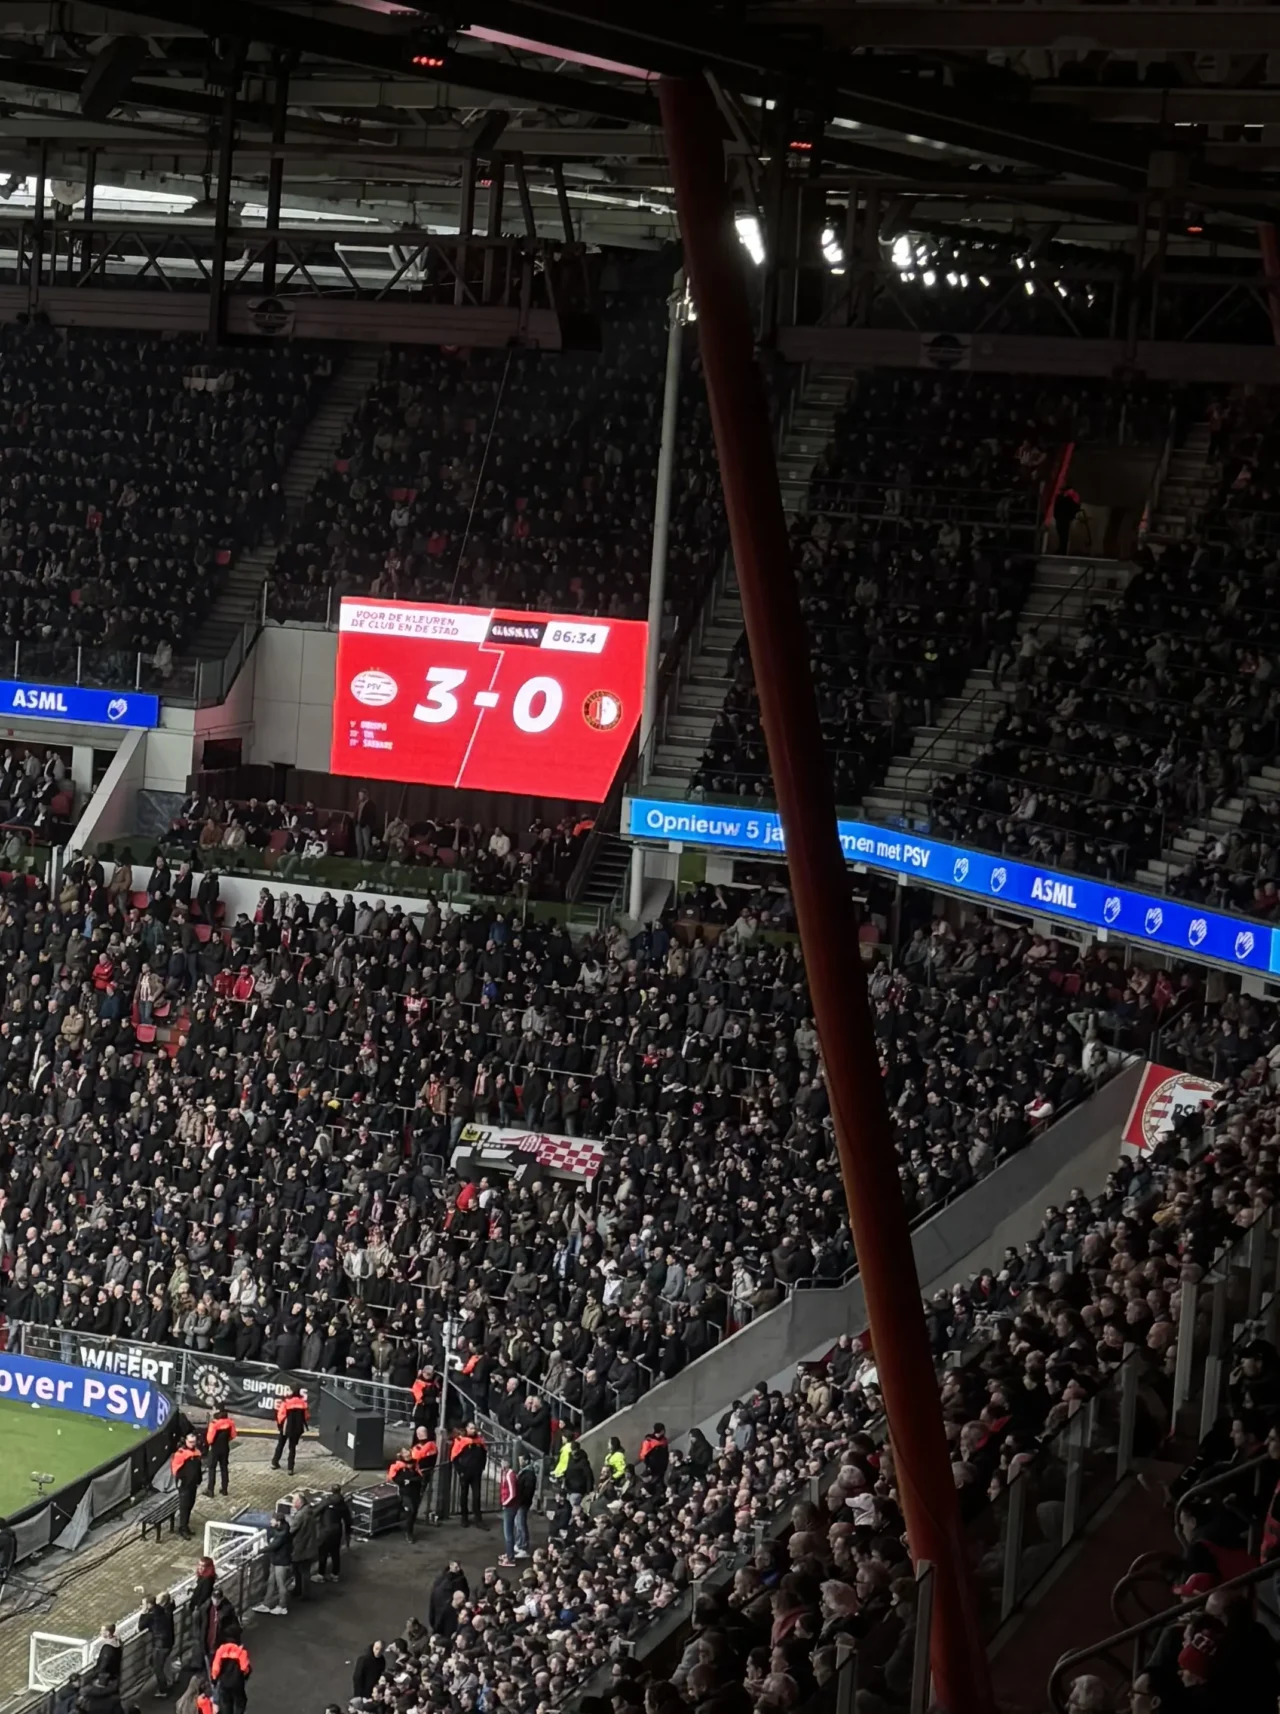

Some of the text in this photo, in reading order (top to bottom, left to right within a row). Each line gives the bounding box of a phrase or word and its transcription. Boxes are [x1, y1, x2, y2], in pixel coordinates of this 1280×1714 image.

[351, 618, 460, 636] DE CLUB EN DE STAD
[356, 610, 455, 626] VOOR DE KLEUREN
[552, 629, 597, 645] 86:34
[12, 689, 68, 712] ASML
[646, 809, 930, 868] Opnieuw 5 ja men met PSV
[1030, 876, 1077, 909] ASML
[83, 1378, 151, 1420] PSV
[242, 1378, 308, 1401] SUPPORS
